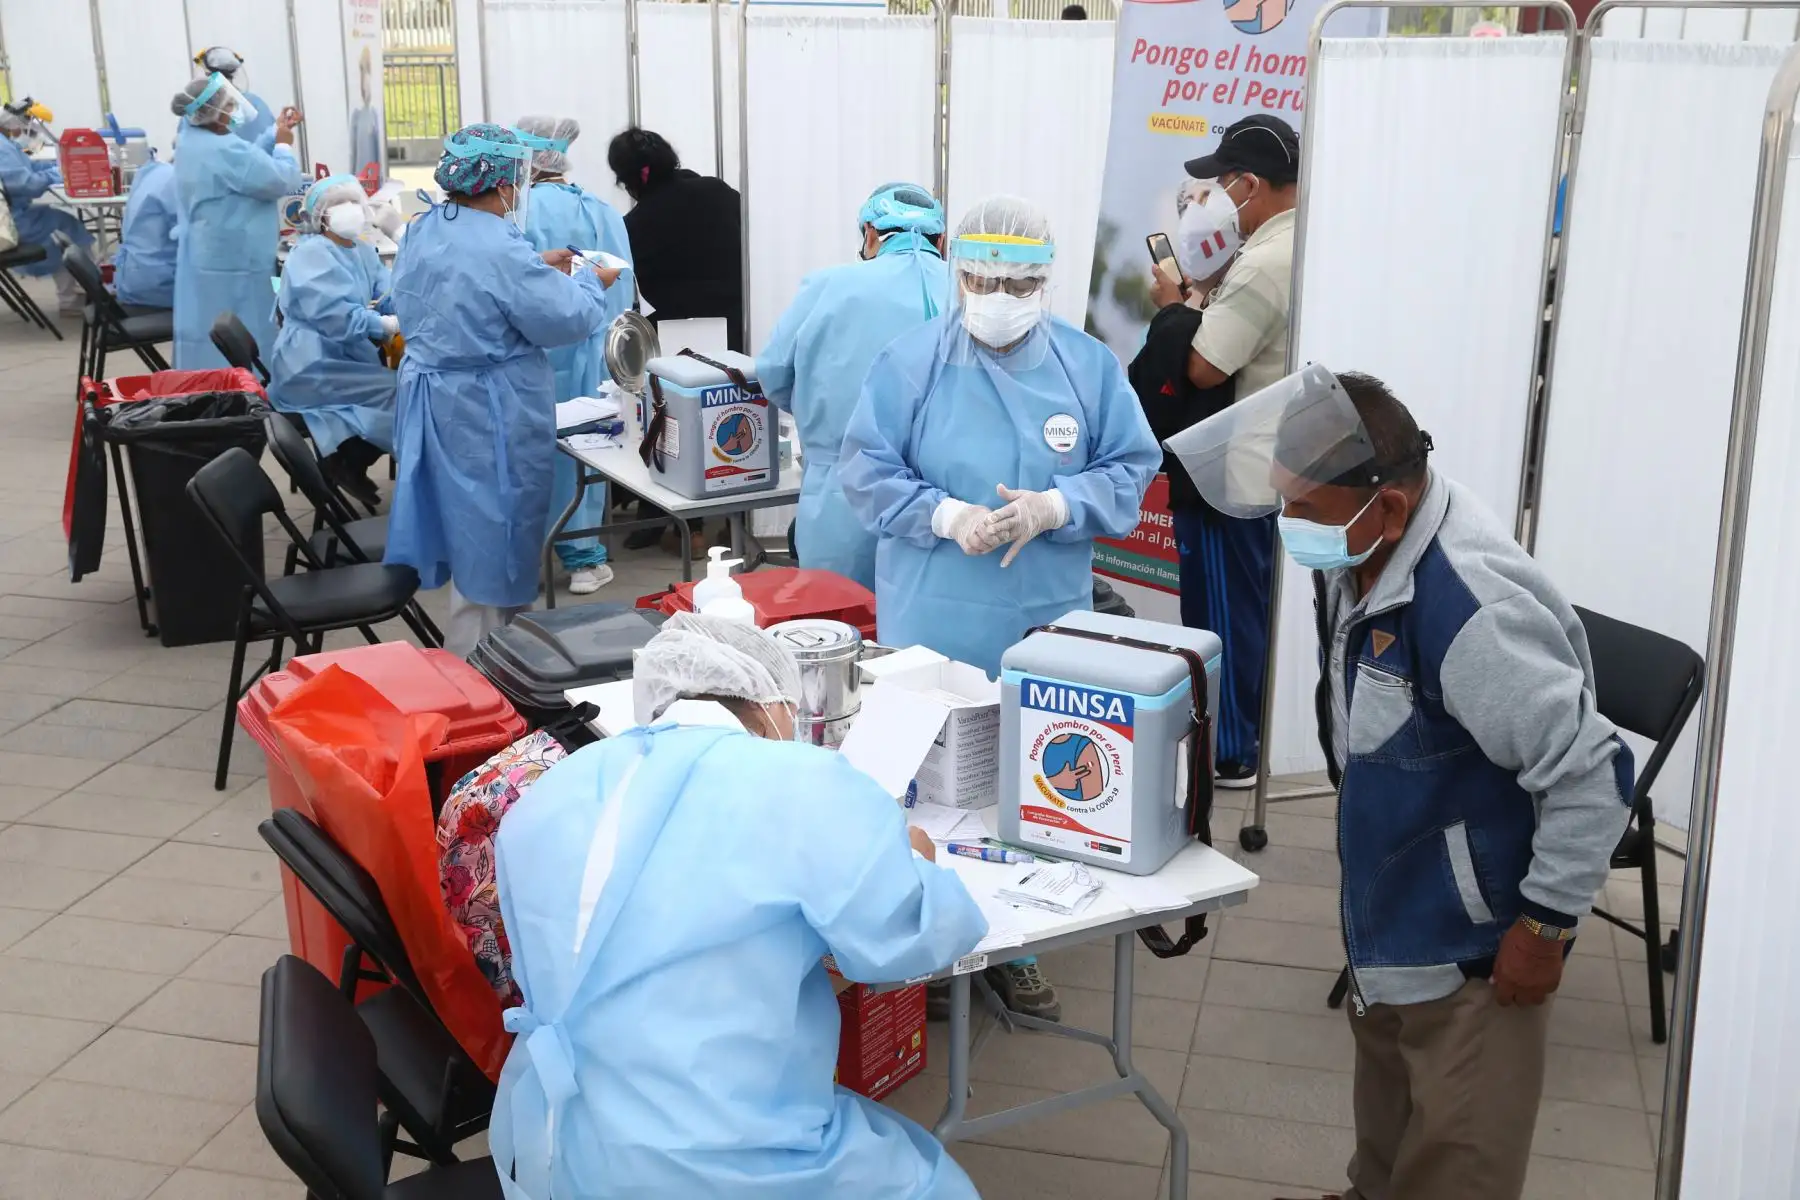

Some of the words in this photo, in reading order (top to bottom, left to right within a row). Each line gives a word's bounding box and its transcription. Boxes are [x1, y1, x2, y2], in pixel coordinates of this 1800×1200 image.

[1131, 38, 1209, 75] Pongo
[1214, 44, 1242, 71] el
[1162, 78, 1209, 106] por
[1212, 78, 1239, 104] el
[1244, 80, 1305, 111] Perú
[1151, 115, 1206, 132] VACÚNATE
[1211, 124, 1227, 135] co
[1045, 426, 1078, 437] MINSA
[1148, 531, 1160, 545] al
[1106, 553, 1155, 574] información
[1029, 683, 1127, 723] MINSA
[1029, 733, 1045, 762] Pongo
[1044, 724, 1052, 735] el
[1051, 720, 1090, 732] hombro
[1089, 728, 1107, 742] por
[1104, 740, 1116, 752] el
[1111, 752, 1124, 776] Perú
[1066, 805, 1088, 814] contra
[1096, 787, 1119, 811] COVID-19
